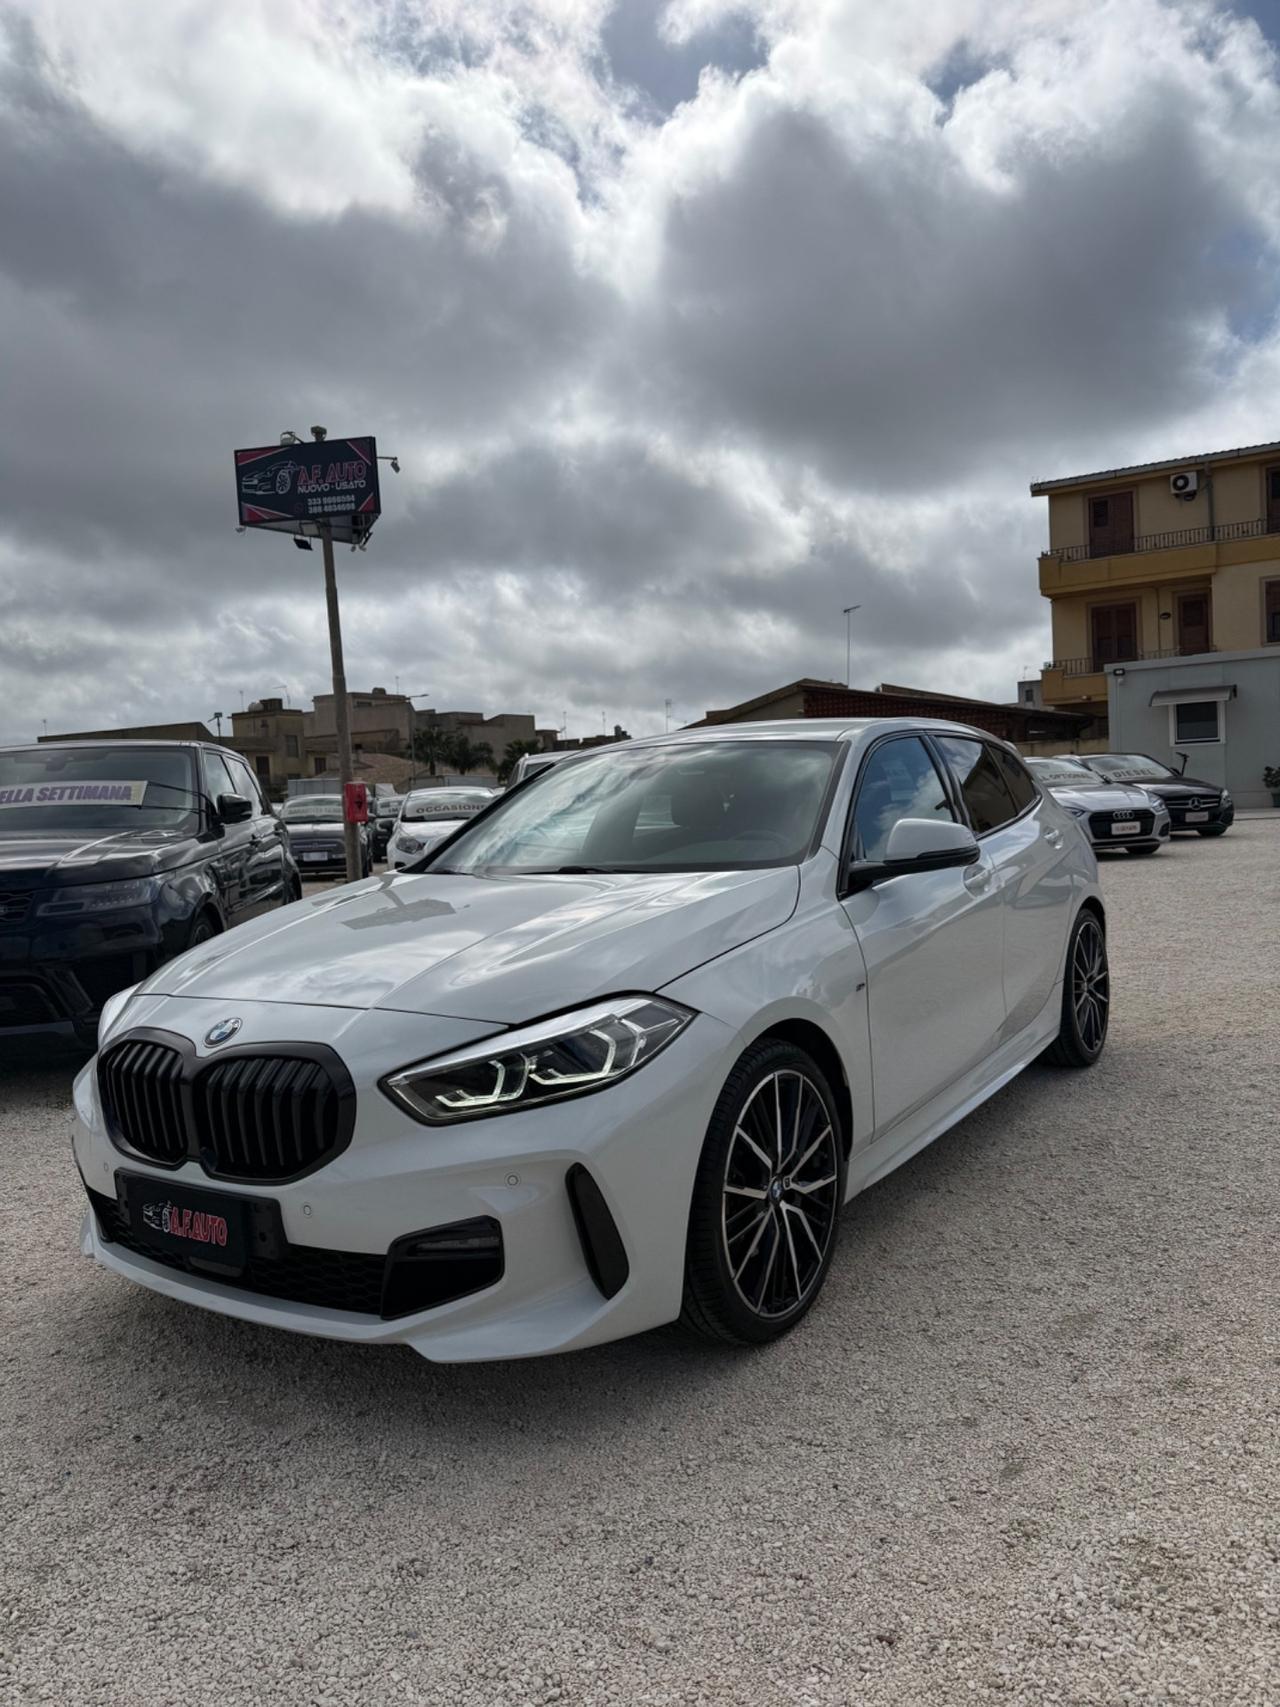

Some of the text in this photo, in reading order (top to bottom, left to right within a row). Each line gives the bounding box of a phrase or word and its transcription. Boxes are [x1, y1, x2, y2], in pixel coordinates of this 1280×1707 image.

[326, 461, 367, 483] AUTO
[297, 483, 330, 494] NUOVO
[336, 480, 367, 490] USATO
[1049, 772, 1092, 780] OPTIONAL
[1112, 768, 1155, 778] DIESEL
[36, 786, 132, 801] SETTIMANA
